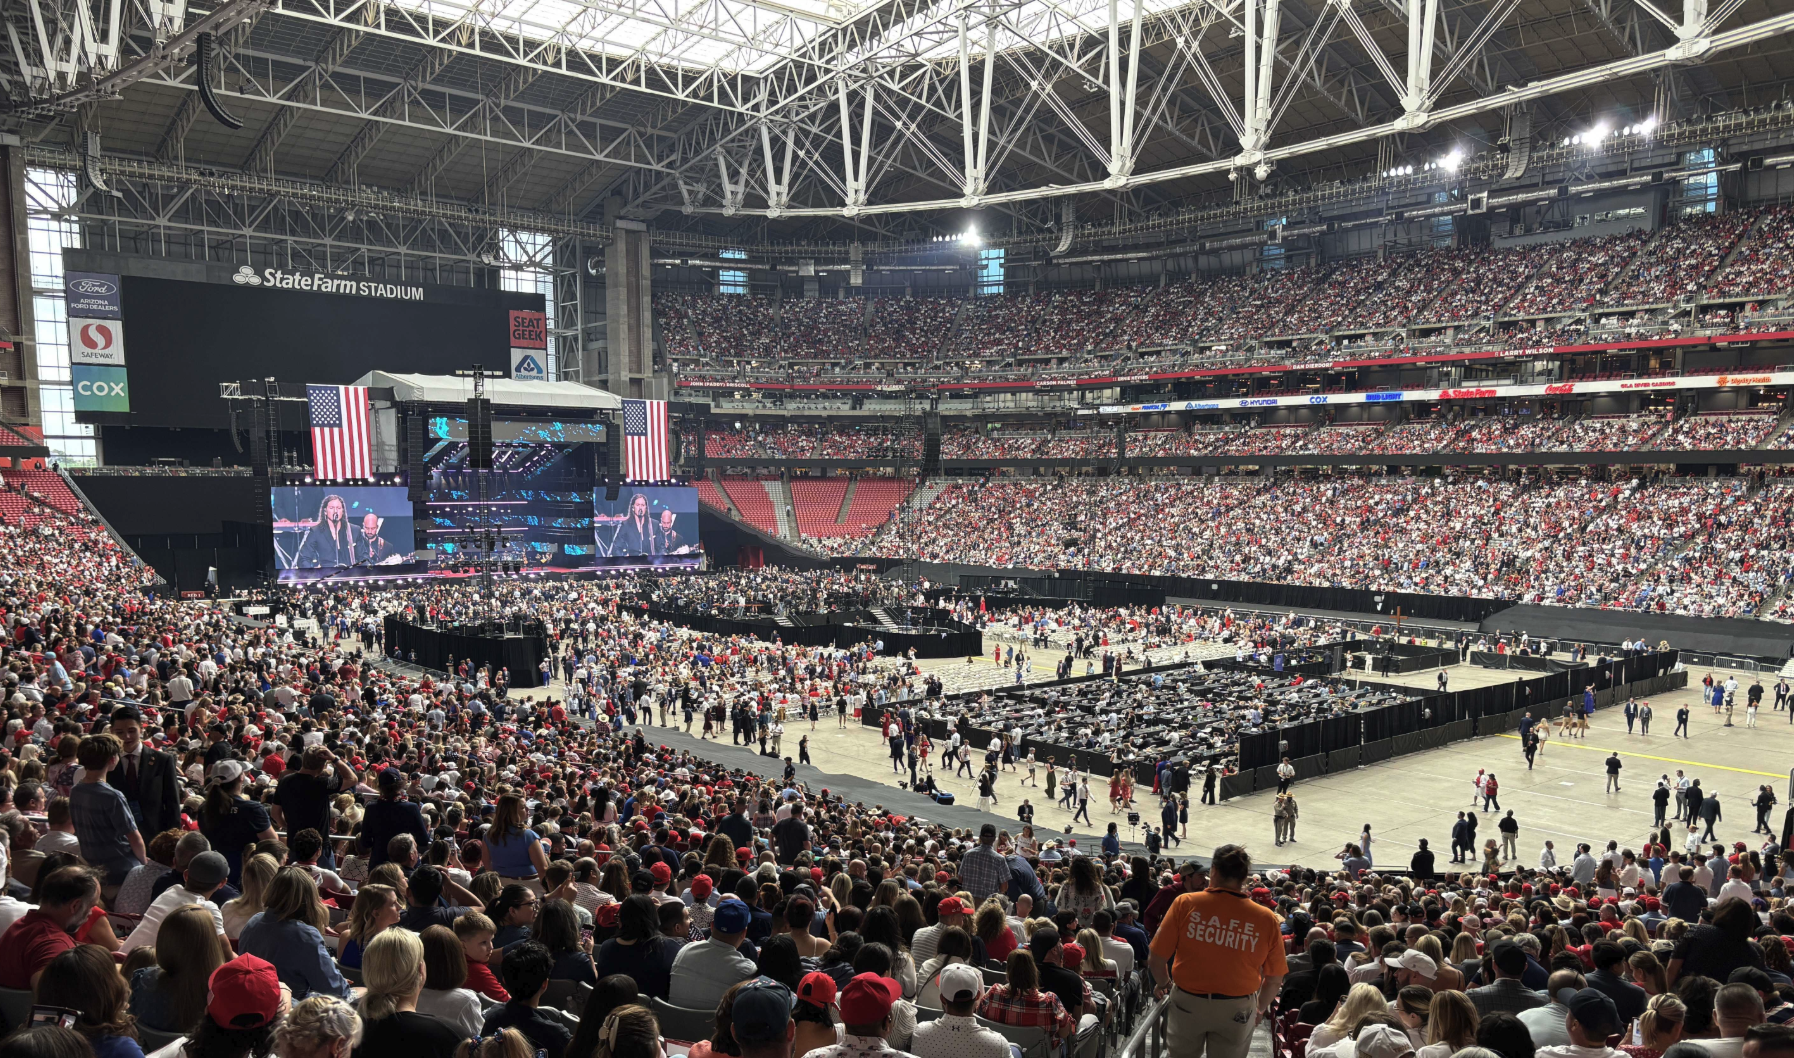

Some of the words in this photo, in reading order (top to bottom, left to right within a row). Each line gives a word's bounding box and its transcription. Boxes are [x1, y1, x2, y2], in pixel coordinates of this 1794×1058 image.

[80, 282, 108, 293] Ford
[360, 283, 424, 300] STADIUM
[514, 316, 542, 329] SEAT
[513, 330, 543, 342] GEEK
[1500, 349, 1524, 357] LARRY
[1525, 347, 1554, 355] WILSON
[1731, 377, 1752, 386] Dignity
[1752, 376, 1772, 384] Health
[78, 381, 124, 397] COX
[1250, 398, 1278, 406] HYUNDAI
[1309, 396, 1328, 404] COX
[1366, 393, 1381, 401] BUD
[1381, 392, 1402, 401] LIGHT
[1190, 912, 1259, 936] S.A.F.E.
[1187, 923, 1258, 952] SECURITY
